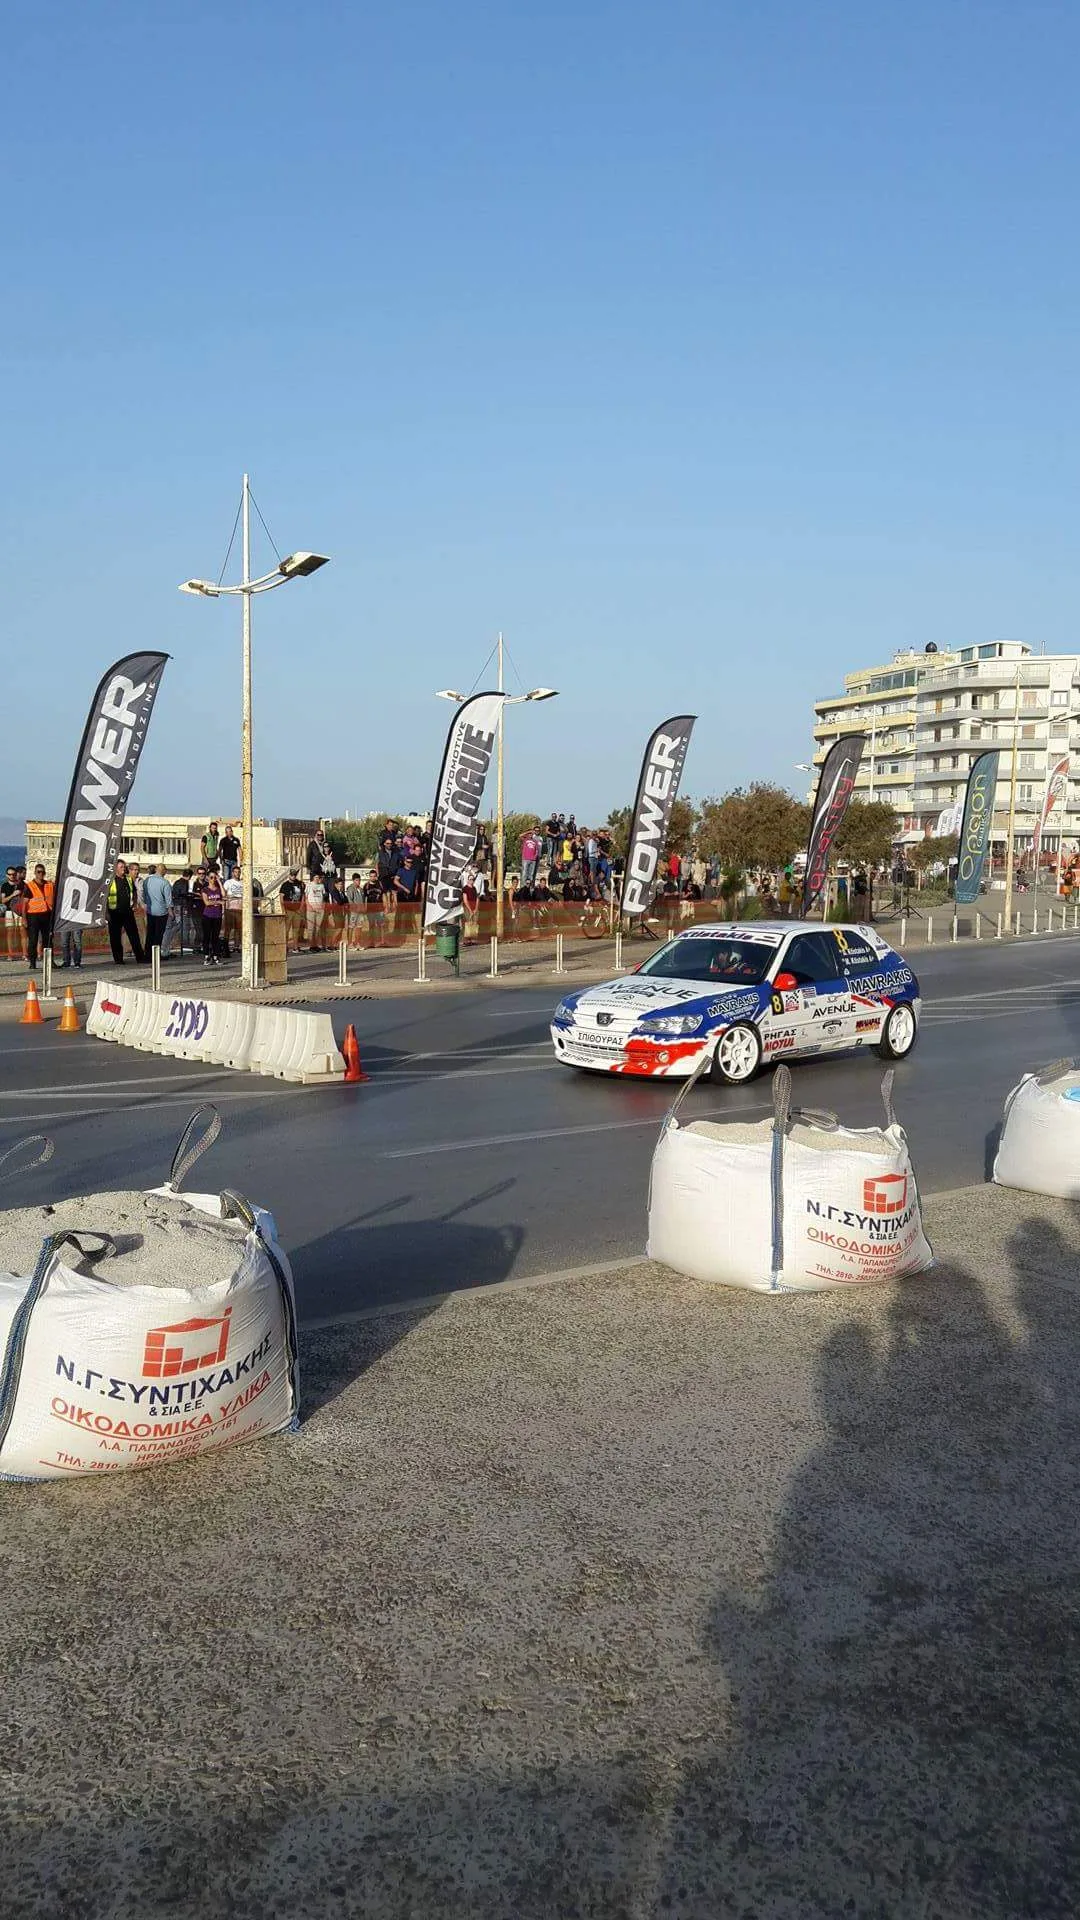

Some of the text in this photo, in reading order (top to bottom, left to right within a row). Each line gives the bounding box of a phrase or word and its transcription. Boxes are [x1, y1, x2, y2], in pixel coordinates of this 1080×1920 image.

[667, 735, 689, 808] MAGAZINE
[60, 674, 147, 925] POWER
[94, 680, 156, 926] AUTOMOTIVE MAGAZINE
[426, 720, 467, 905] POWER AUTOMOTIVE
[437, 722, 495, 910] CATALOGUE
[622, 733, 682, 914] POWER
[678, 930, 754, 941] Ktistakis
[831, 927, 850, 952] 8
[599, 983, 699, 1000] AVENUE
[850, 968, 913, 994] MAVRAKIS
[707, 992, 760, 1018] MAVRAKIS
[772, 994, 782, 1013] 8
[812, 1002, 857, 1019] AVENUE
[577, 1032, 624, 1046] ΣΠΙΘΟΥΡΑΣ
[763, 1037, 795, 1053] MOTUL
[764, 1028, 797, 1041] ΡΗΓΑΣ
[806, 1226, 902, 1255] ΟΙΚΟΔΟΜΙΚΑ
[51, 1370, 271, 1438] ΟΙΚΟΔΟΜΙΚΑ ΥΛΙΚΑ
[149, 1406, 158, 1416] &
[161, 1406, 181, 1416] ΣΙΑ
[99, 1439, 125, 1452] Λ.Α.
[128, 1427, 218, 1453] ΠΑΠΑΝΔΡΕΟΥ
[56, 1451, 86, 1468] ΤΗΛ:
